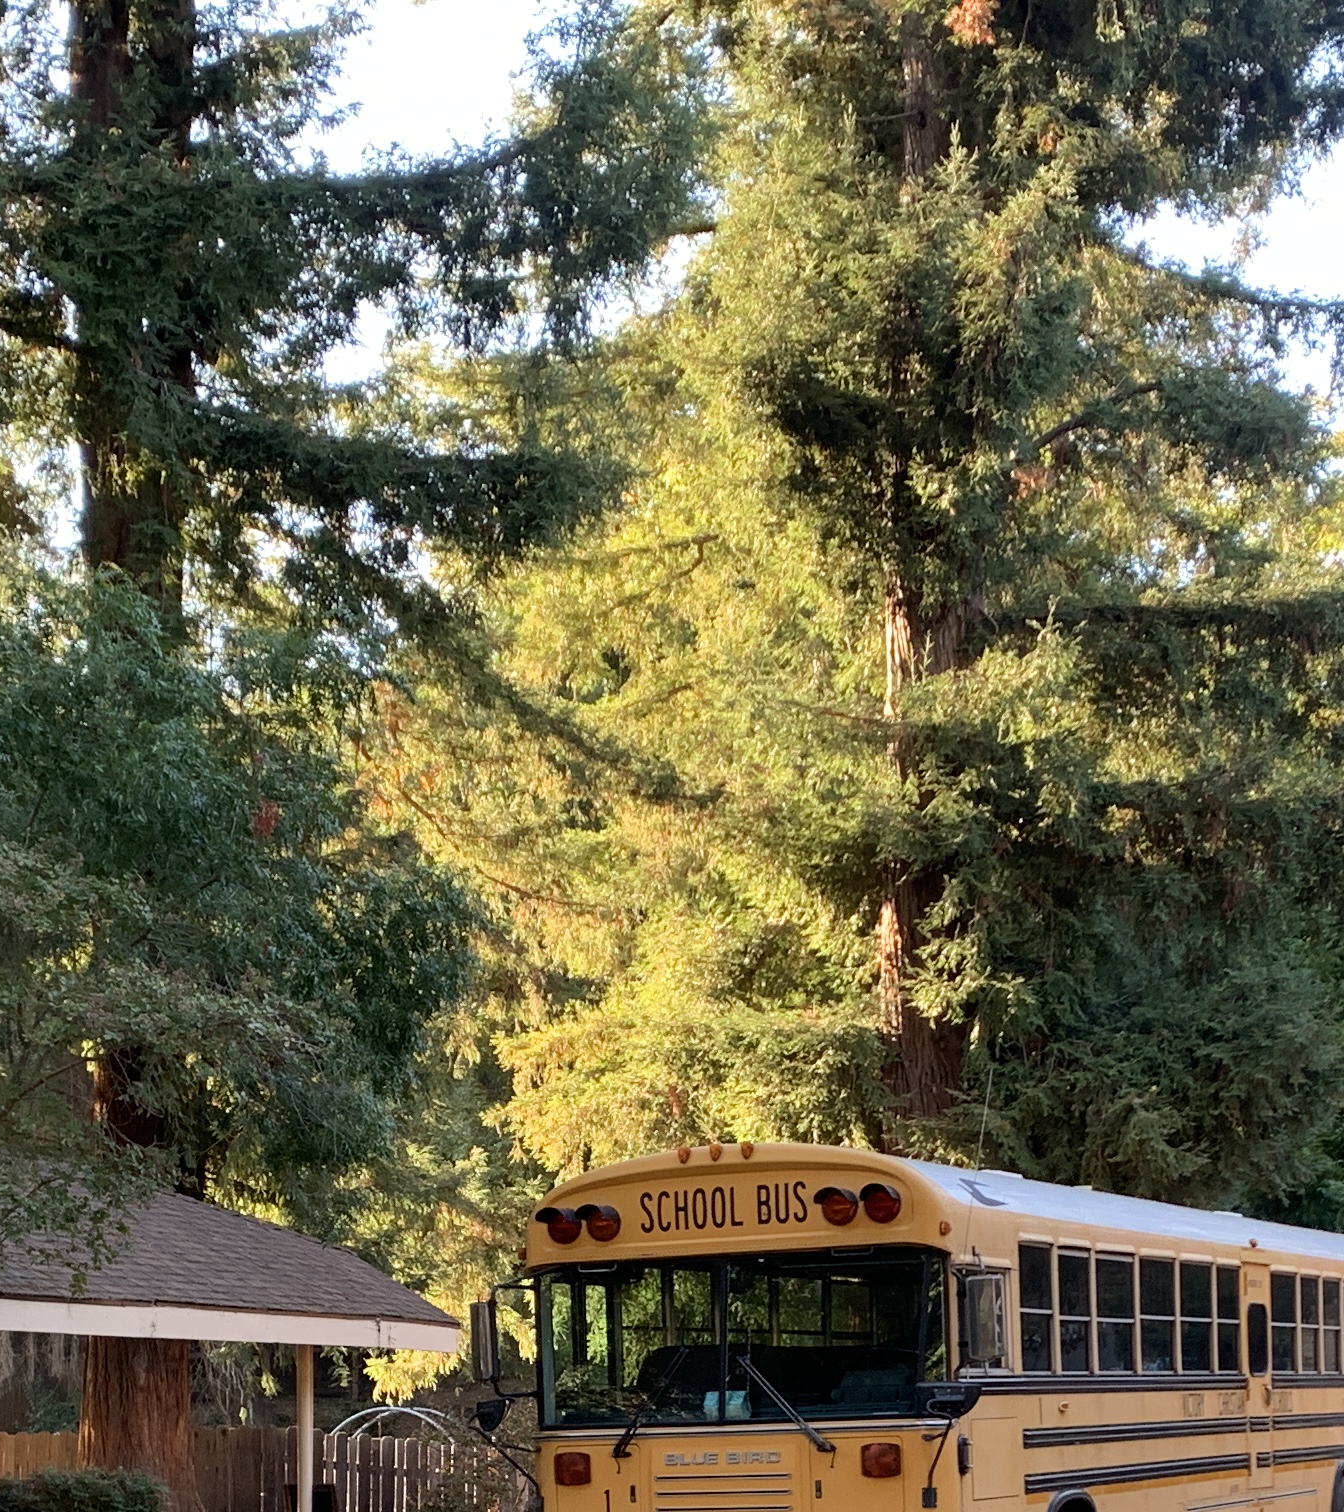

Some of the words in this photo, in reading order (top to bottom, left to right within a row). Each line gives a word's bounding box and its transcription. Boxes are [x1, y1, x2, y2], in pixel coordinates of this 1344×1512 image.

[639, 1186, 744, 1234] SCHOOL
[756, 1181, 808, 1225] BUS
[664, 1453, 718, 1466] BLUE
[726, 1451, 781, 1465] BIRD
